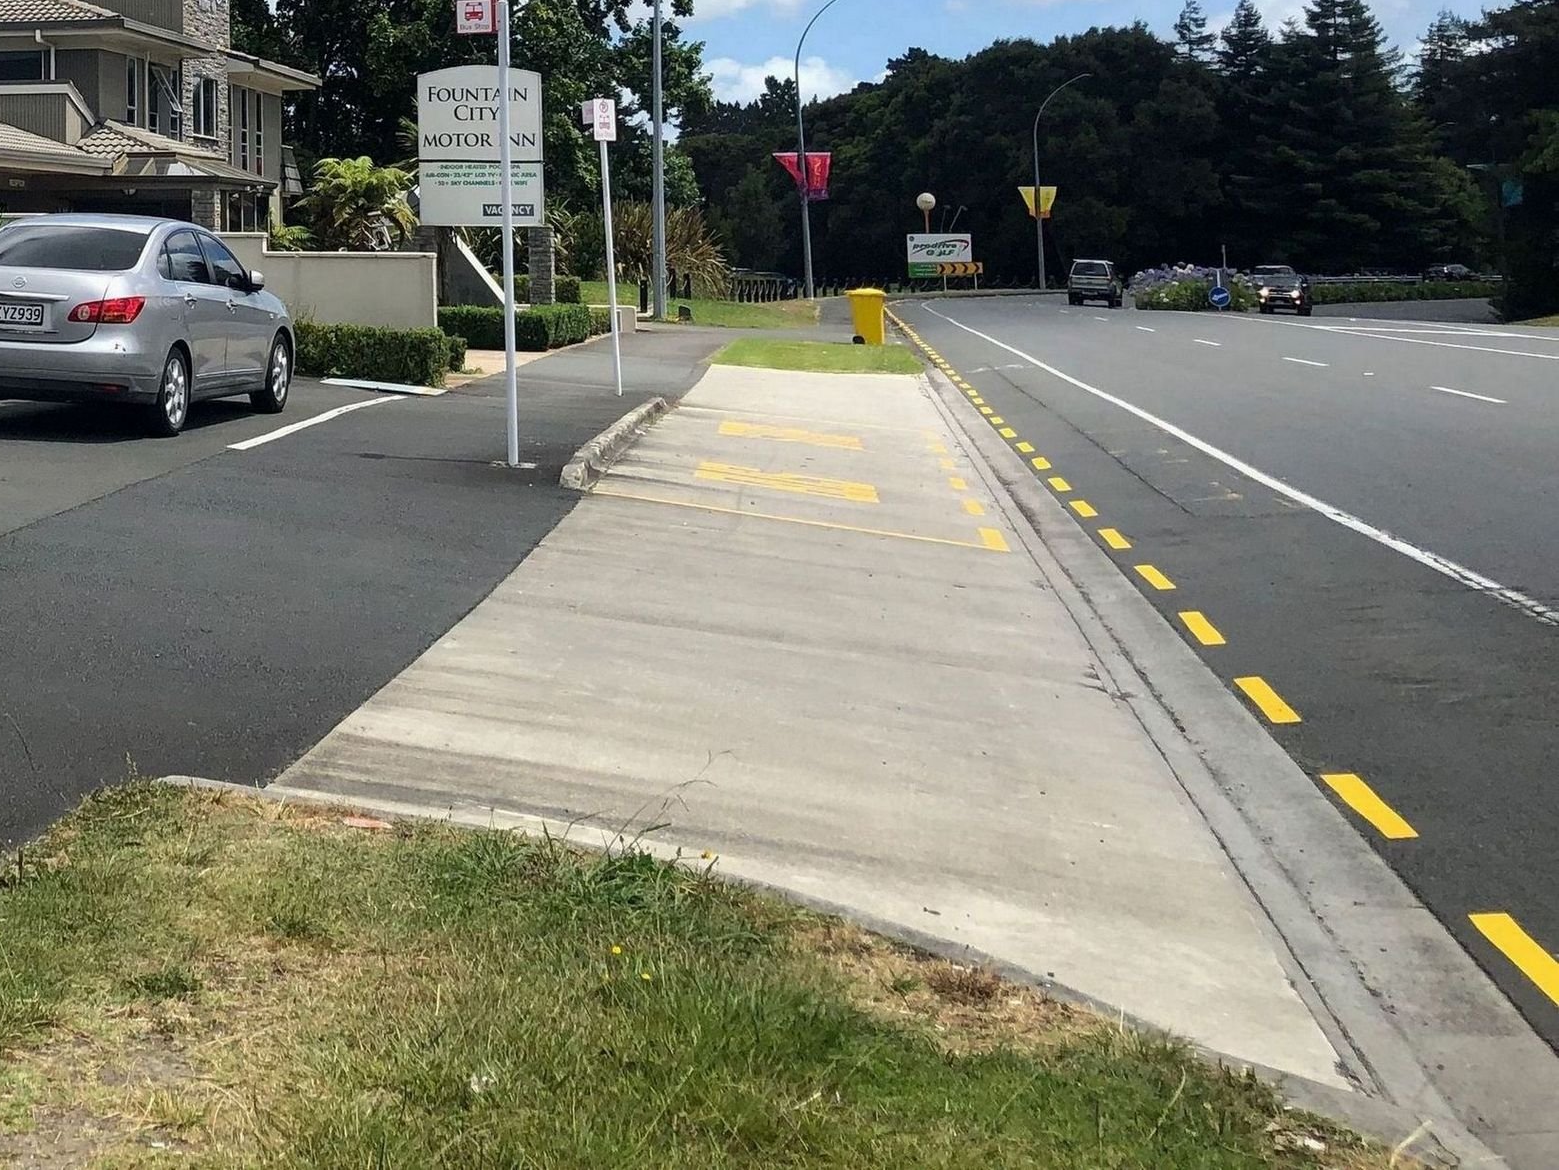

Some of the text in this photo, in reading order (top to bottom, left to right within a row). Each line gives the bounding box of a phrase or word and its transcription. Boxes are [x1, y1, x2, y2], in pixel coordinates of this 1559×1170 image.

[454, 105, 500, 121] CITY
[423, 133, 536, 148] MOTOR NN
[485, 206, 531, 215] VACNCY
